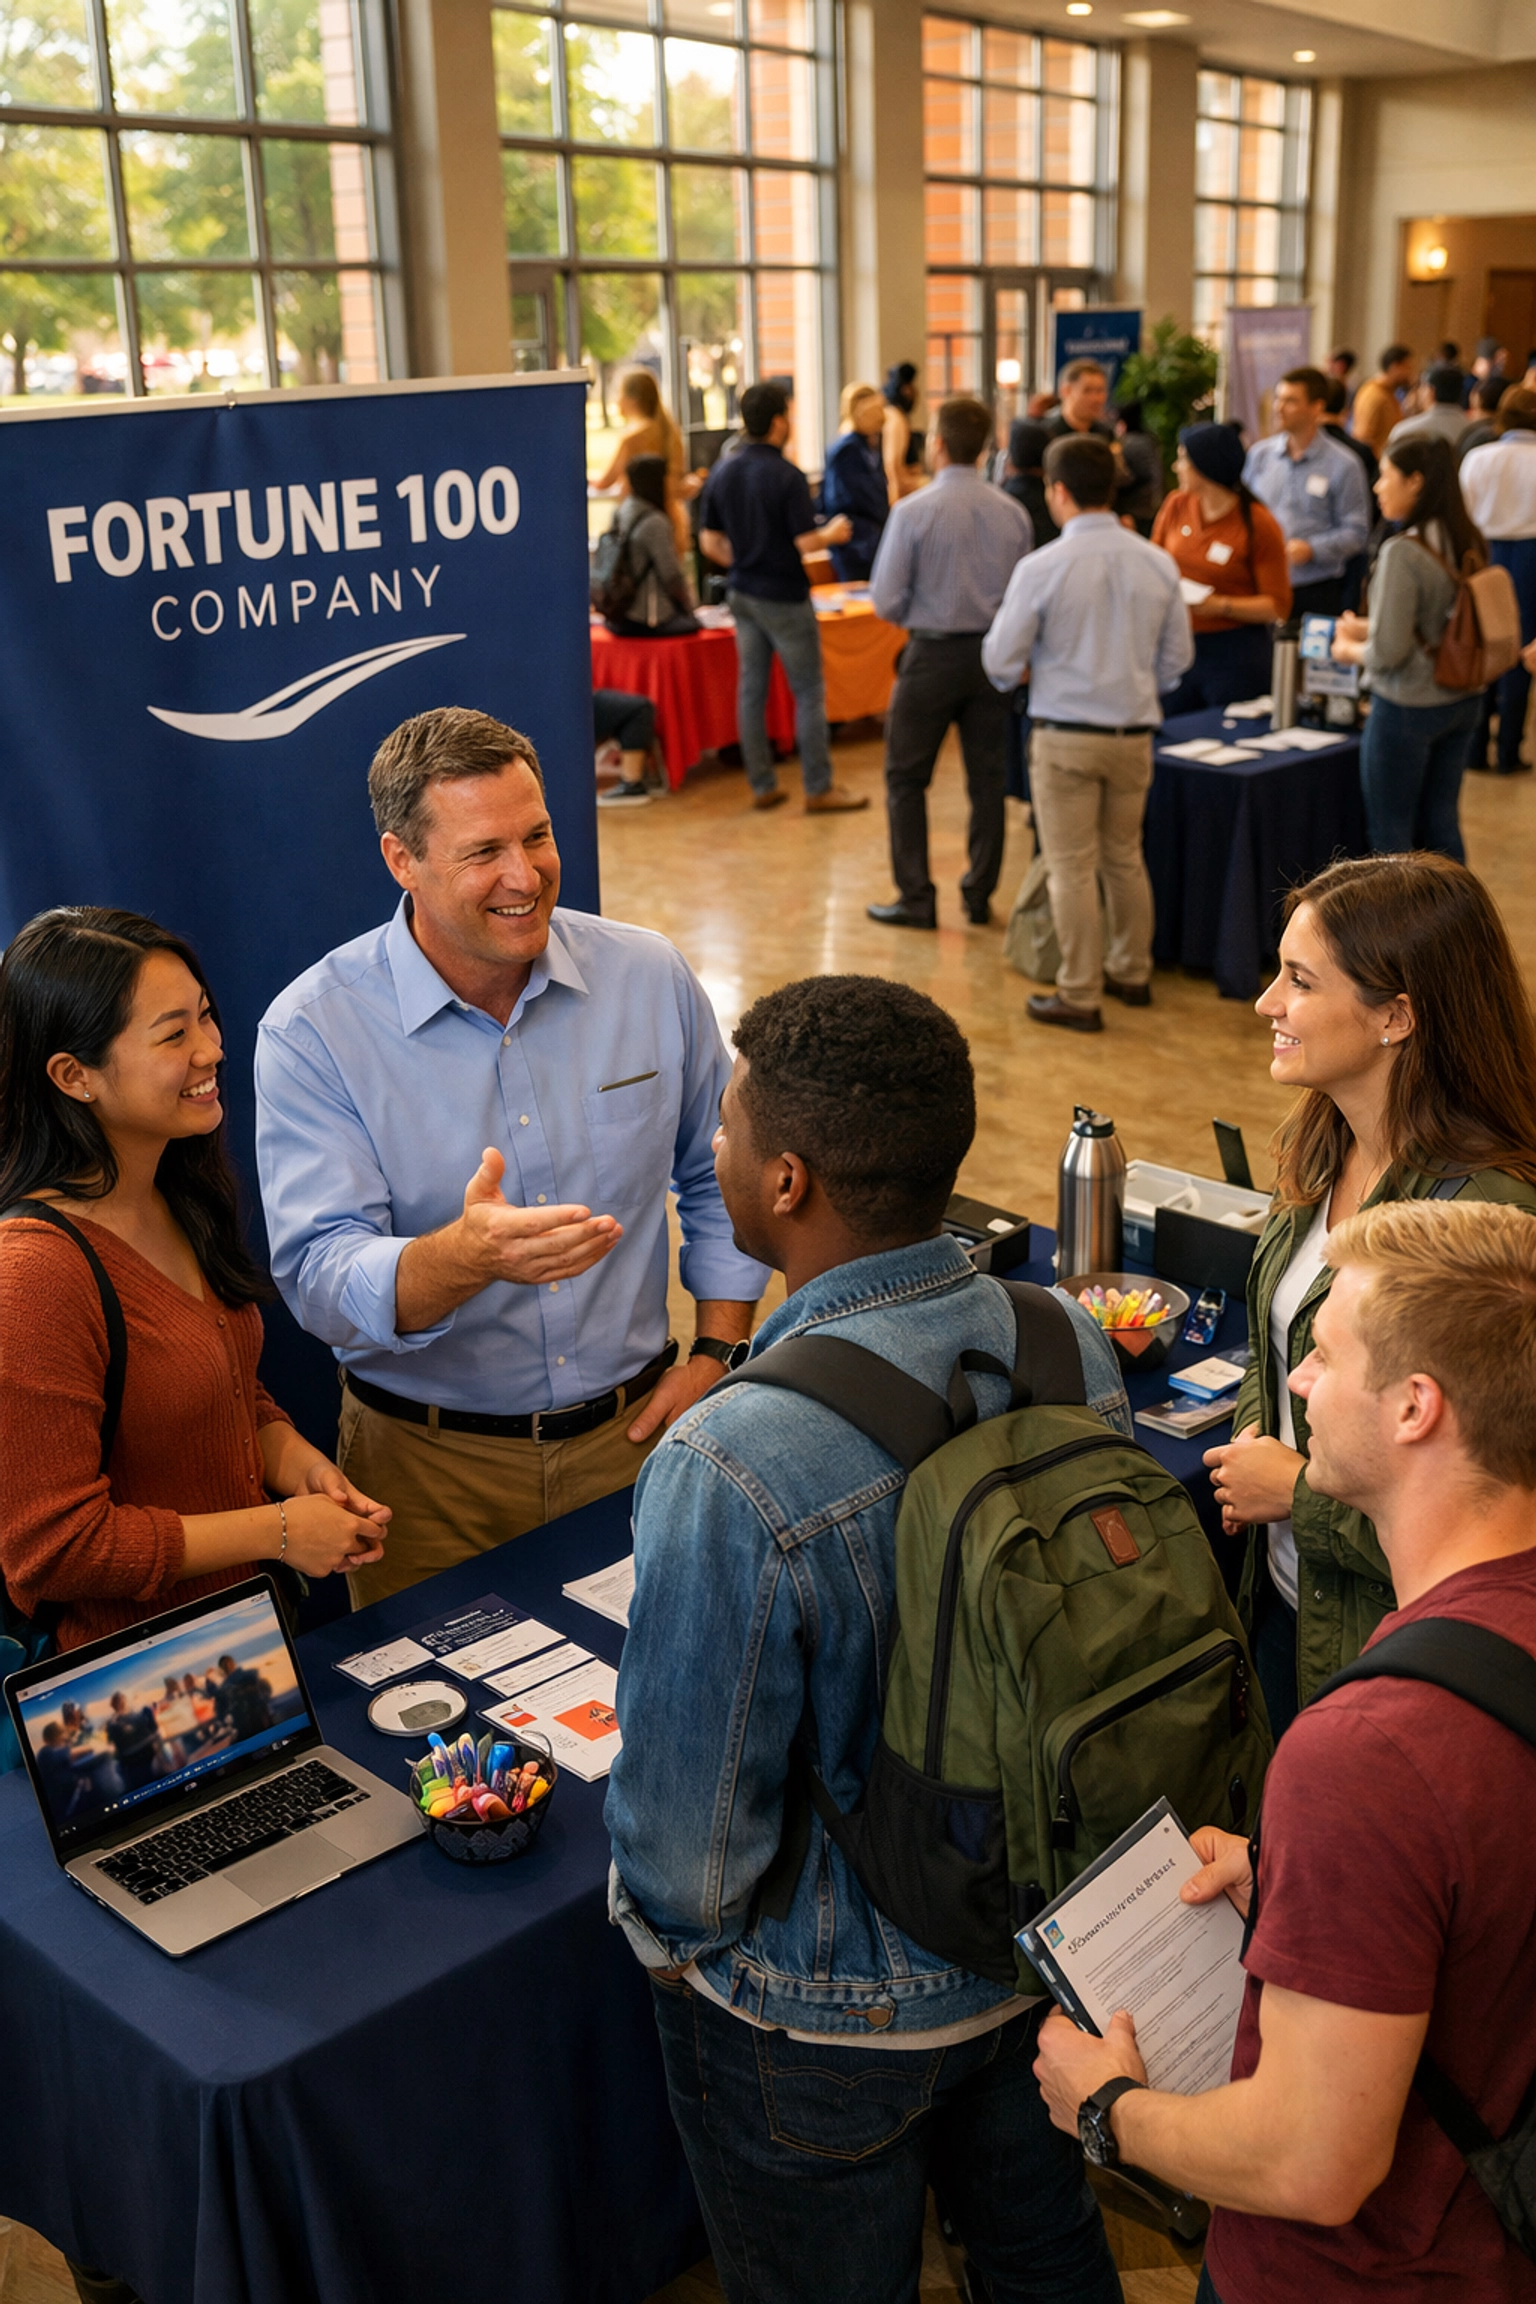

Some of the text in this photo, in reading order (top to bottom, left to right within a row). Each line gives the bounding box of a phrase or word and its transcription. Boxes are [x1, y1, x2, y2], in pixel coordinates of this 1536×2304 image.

[46, 466, 521, 584] FORTUNE 100
[150, 564, 442, 642] COMPANY
